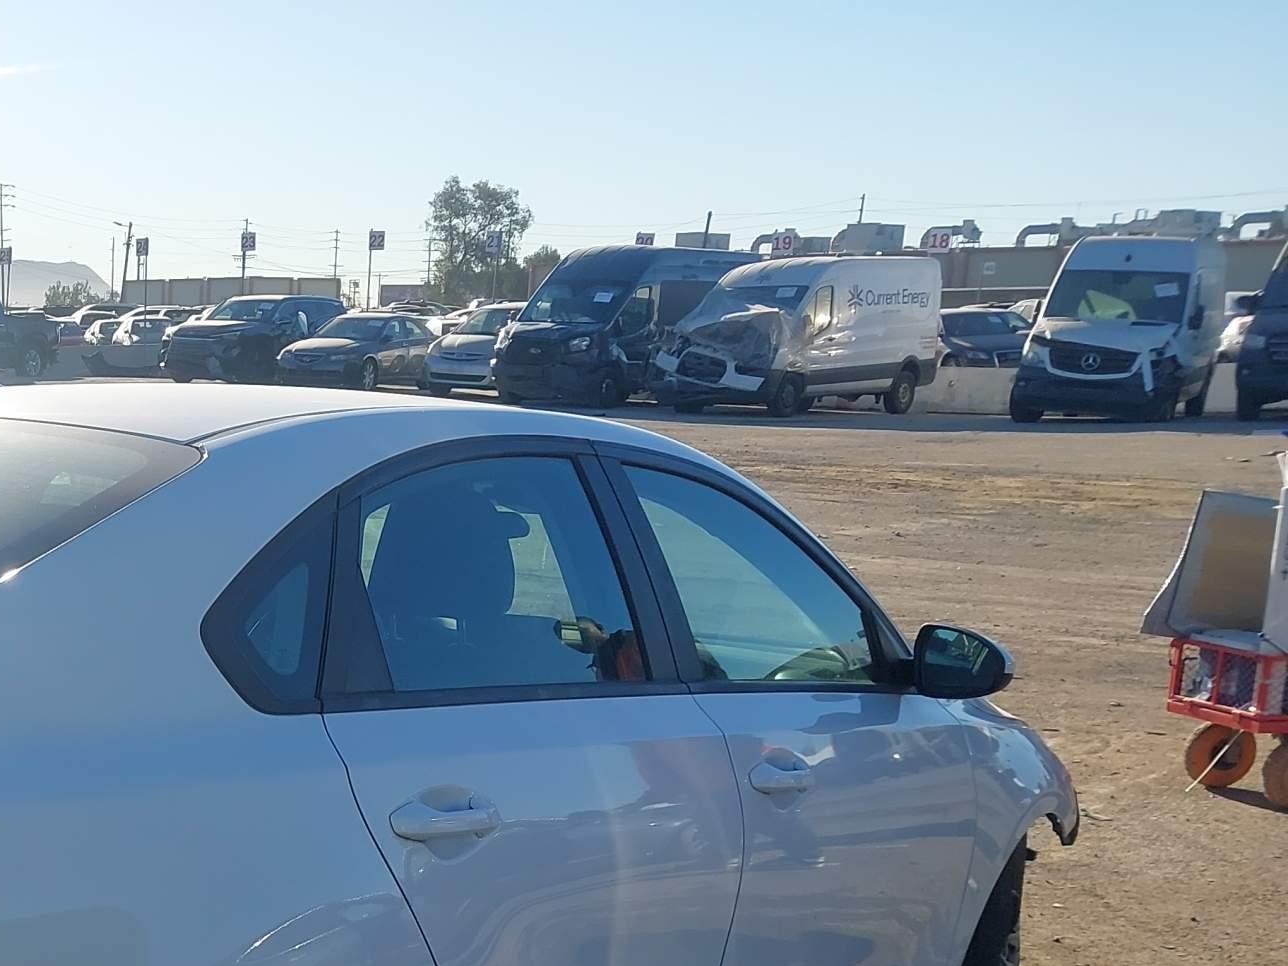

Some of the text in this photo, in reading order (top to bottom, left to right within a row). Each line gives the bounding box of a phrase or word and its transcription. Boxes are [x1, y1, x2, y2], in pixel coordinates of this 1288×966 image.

[242, 236, 256, 249] 23
[369, 235, 384, 248] 22
[773, 235, 793, 250] 19
[929, 233, 950, 249] 18
[865, 288, 930, 308] Current Energy
